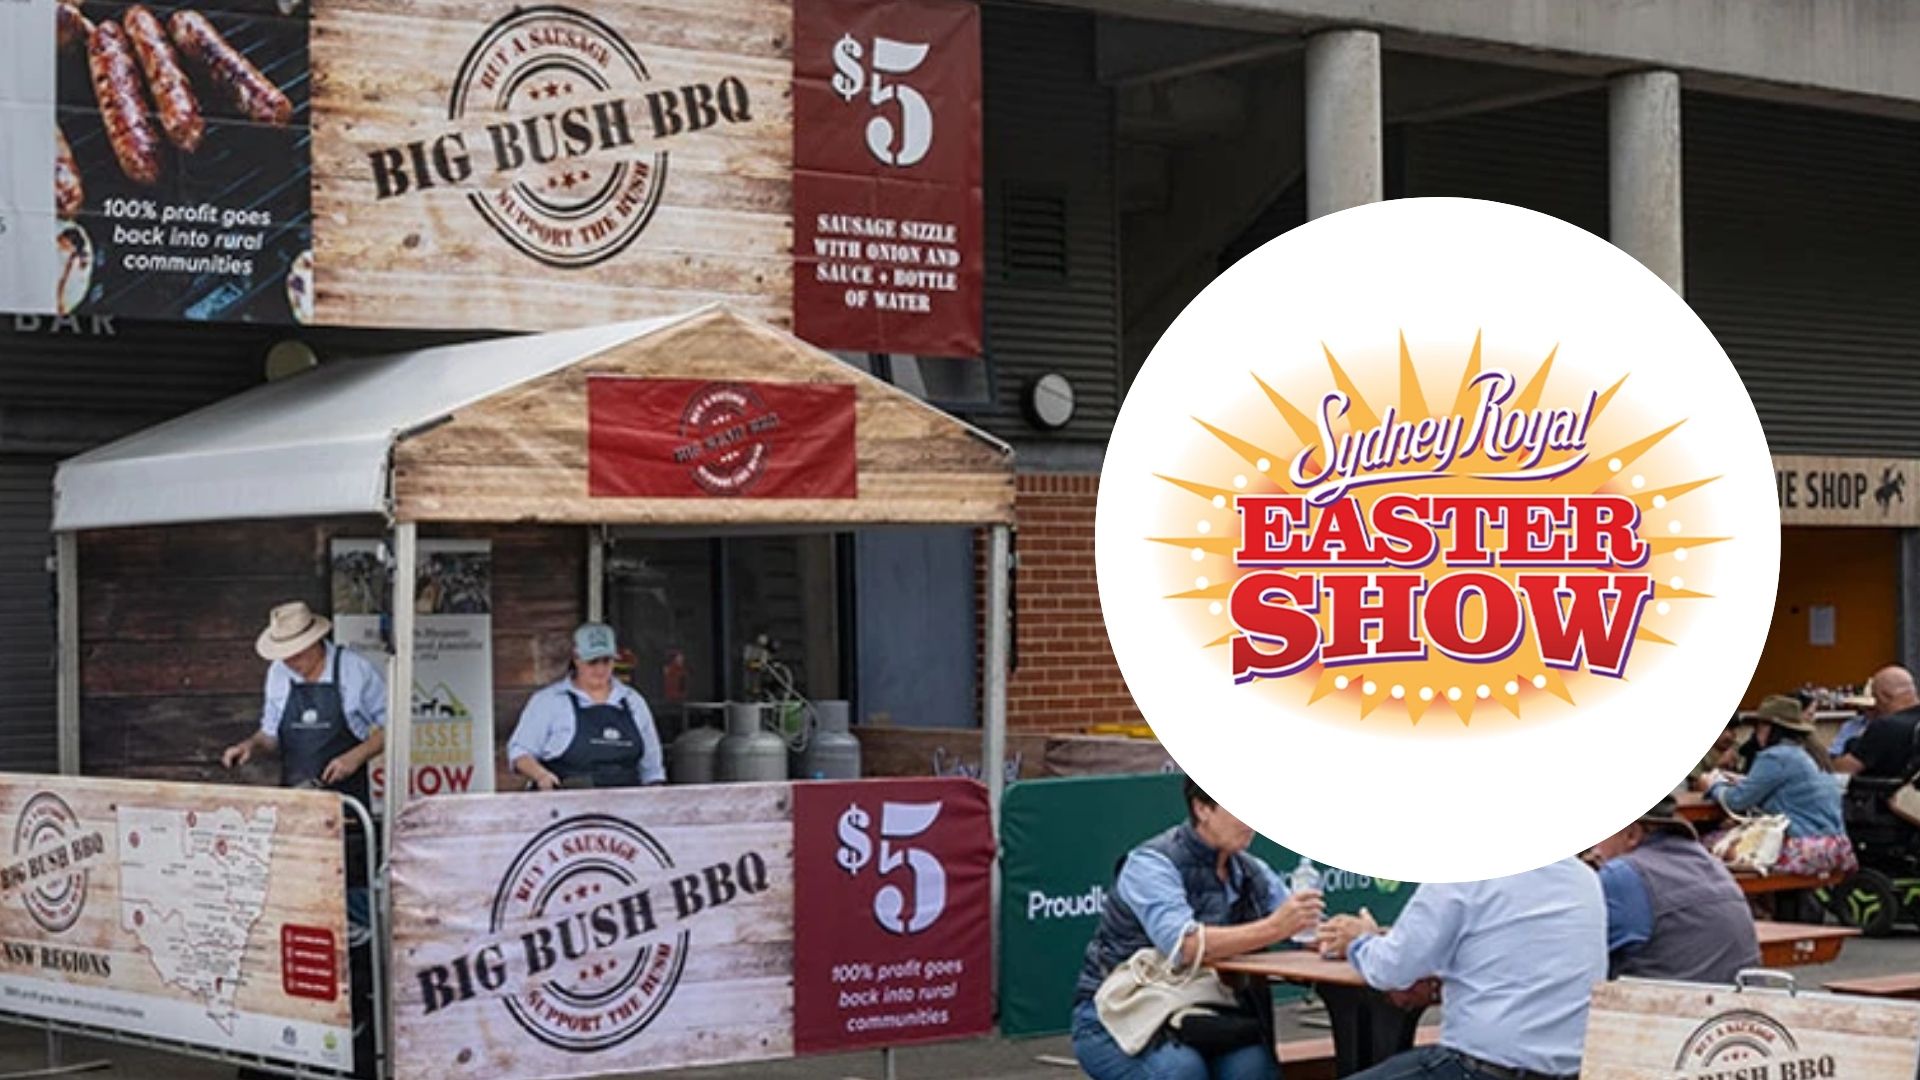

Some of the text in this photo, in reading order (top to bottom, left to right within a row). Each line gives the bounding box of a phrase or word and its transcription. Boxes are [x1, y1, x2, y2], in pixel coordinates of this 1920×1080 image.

[480, 28, 611, 90] BUY A SAUSAGE
[832, 34, 934, 166] $5
[369, 76, 753, 199] BIG BUSH BBQ
[104, 199, 271, 228] 100% profit goes
[497, 160, 650, 247] SUPPORT THE BUSH
[113, 226, 264, 250] back into rural
[817, 213, 957, 244] SAUSAGE SIZZLE
[122, 253, 253, 276] communities
[814, 237, 961, 268] WITH ONION AND
[817, 263, 874, 285] SAUCE
[893, 267, 957, 291] BOTTLE
[844, 289, 930, 312] OF WATER
[1805, 471, 1868, 509] SHOP
[28, 845, 71, 879] BUSH
[515, 834, 639, 902] BUY A SAUSAGE
[837, 801, 947, 935] $5
[417, 850, 769, 1015] BIG BUSH BBQ
[2, 941, 112, 979] NSW REGIONS
[832, 959, 962, 982] 100% profit goes
[528, 943, 671, 1032] SUPPORT THE BUSH
[838, 981, 958, 1008] back into rural
[847, 1008, 949, 1032] communities
[1779, 1054, 1836, 1080] BBQ
